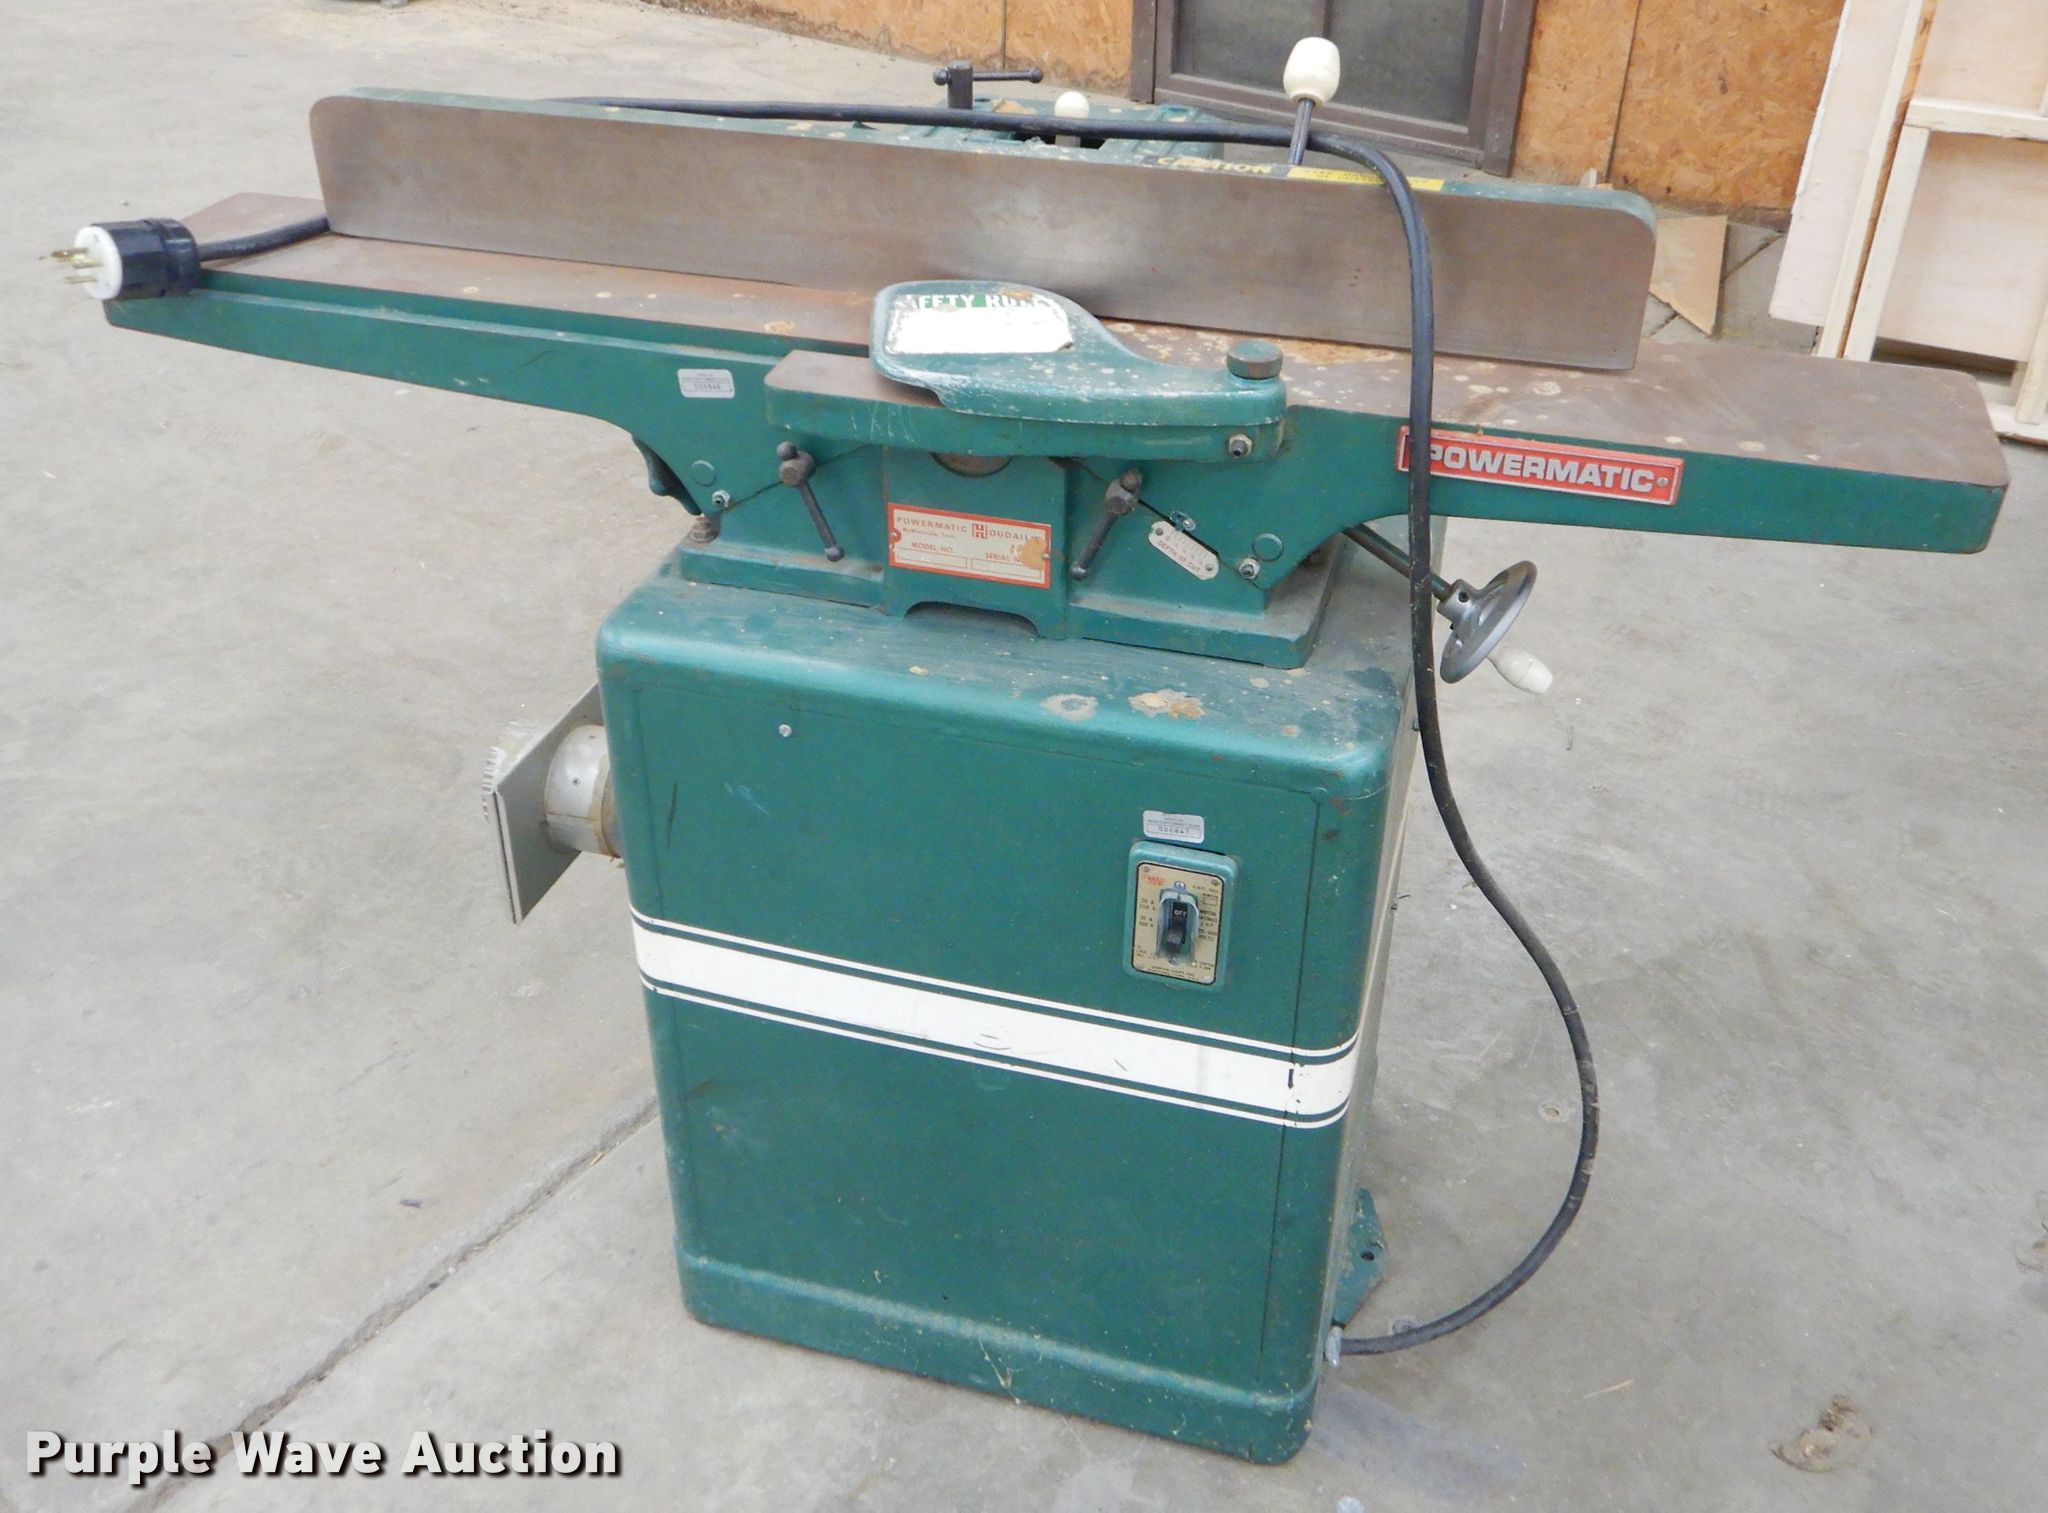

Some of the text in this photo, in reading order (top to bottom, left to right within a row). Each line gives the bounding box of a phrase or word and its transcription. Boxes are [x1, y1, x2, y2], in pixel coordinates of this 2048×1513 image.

[896, 516, 968, 533] POWERMATIC
[911, 542, 938, 552] MODEL
[985, 552, 1010, 561] SERIAL
